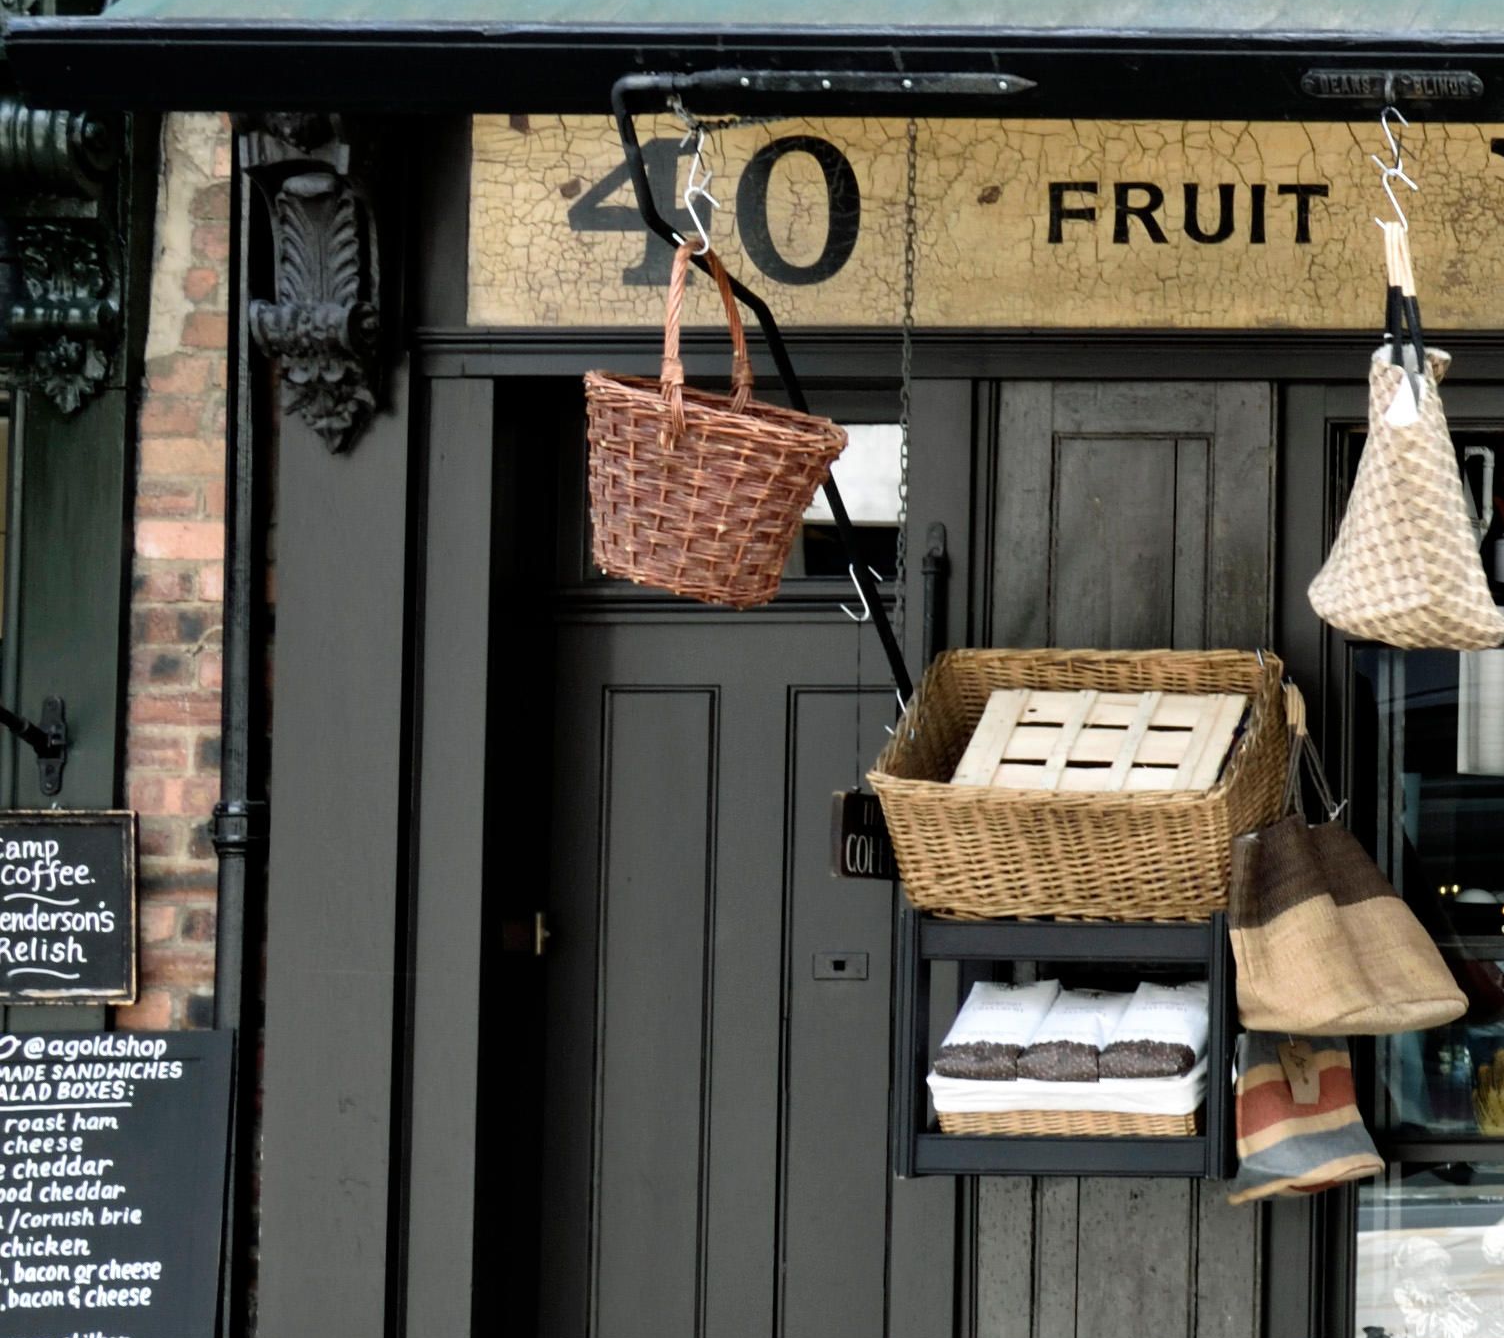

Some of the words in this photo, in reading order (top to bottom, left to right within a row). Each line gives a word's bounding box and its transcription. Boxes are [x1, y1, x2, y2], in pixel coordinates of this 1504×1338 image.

[567, 133, 861, 288] 40
[1046, 178, 1331, 246] FRUIT
[23, 1034, 167, 1061] @agoldshop
[51, 1061, 183, 1081] SANDWICHES
[57, 1081, 135, 1101] BOXES:
[4, 1112, 67, 1134] roast
[72, 1112, 119, 1132] ham
[3, 1135, 84, 1155] cheese
[12, 1154, 114, 1179] cheddar
[39, 1180, 126, 1203] cheddar
[100, 1207, 143, 1226] brie
[0, 1234, 91, 1258] chicken
[14, 1261, 71, 1283] bacon
[74, 1264, 98, 1285] or
[98, 1258, 162, 1281] cheese
[67, 1285, 81, 1309] &
[84, 1284, 152, 1308] cheese
